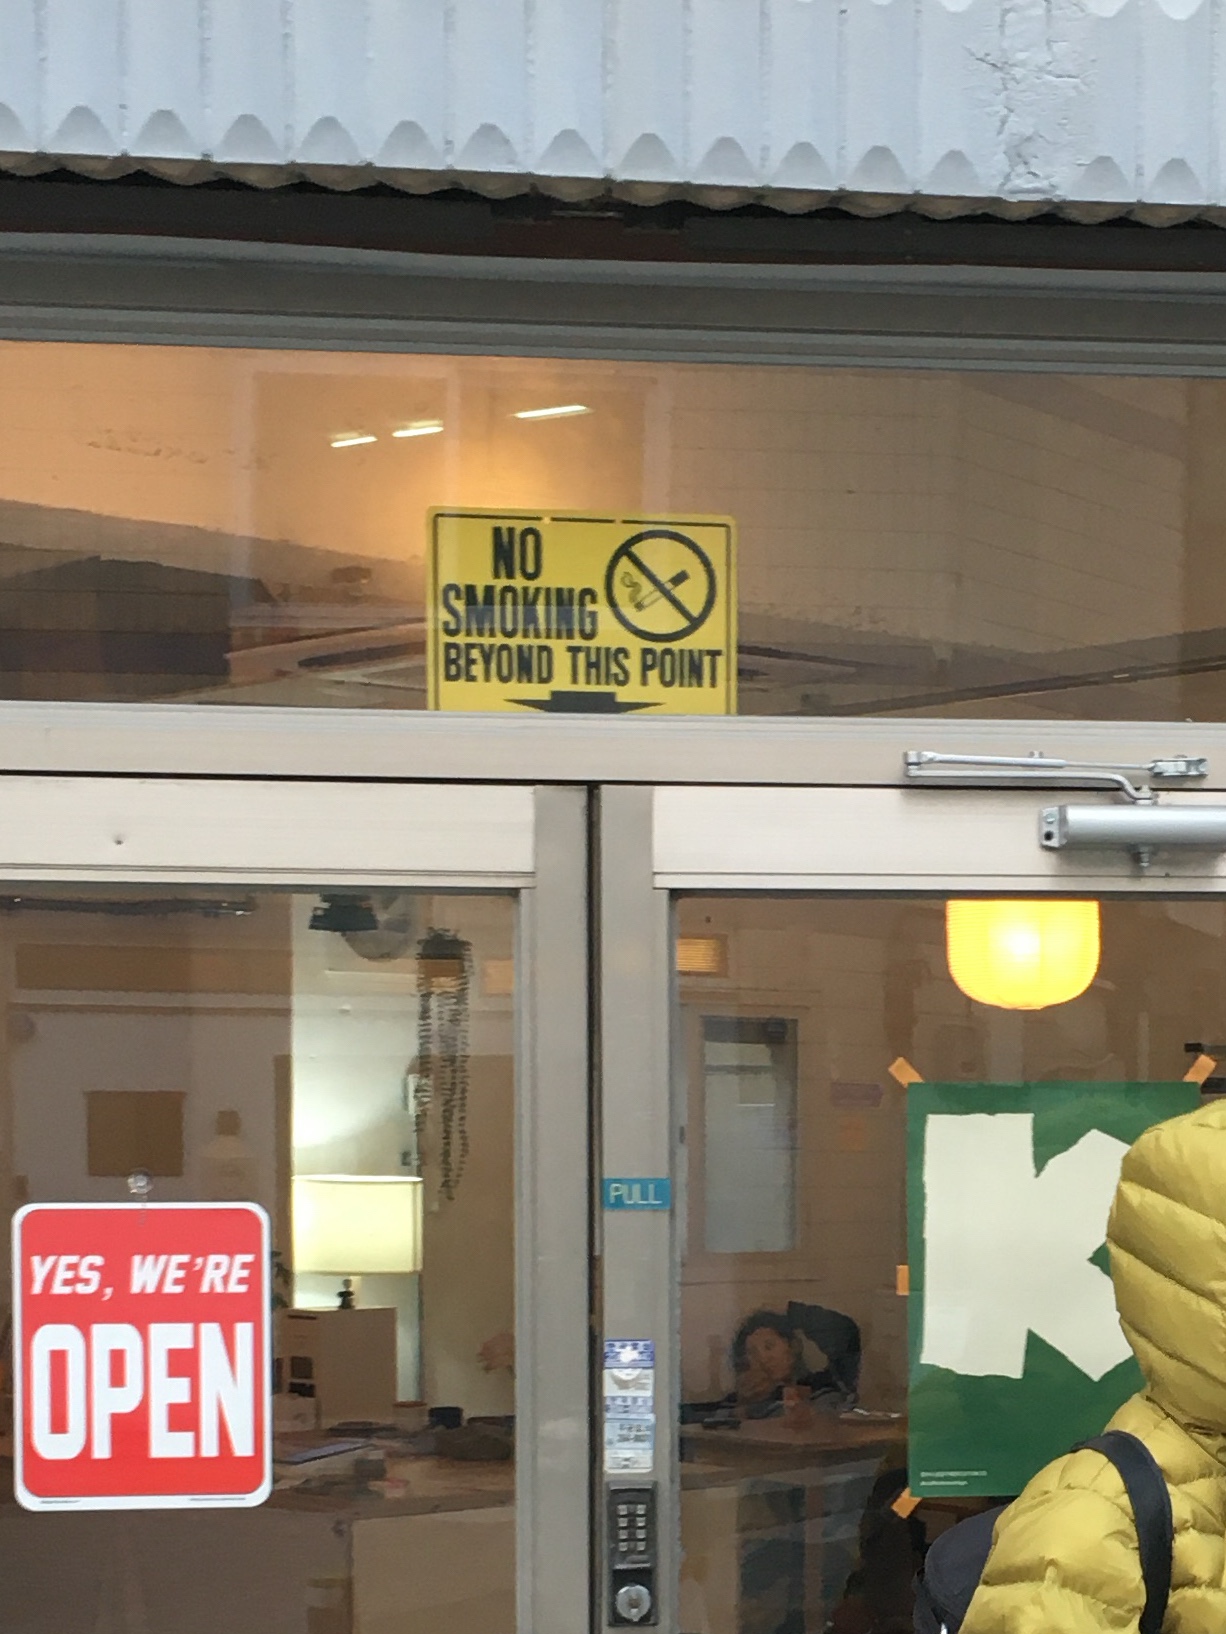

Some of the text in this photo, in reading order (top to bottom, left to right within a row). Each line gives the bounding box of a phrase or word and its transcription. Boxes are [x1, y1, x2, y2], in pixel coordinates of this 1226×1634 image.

[493, 526, 543, 581] NO
[442, 583, 599, 641] SMOKING
[444, 642, 723, 689] BEYOND THIS POINT
[609, 1183, 662, 1205] PULL
[30, 1253, 255, 1301] YES, WE'RE
[31, 1322, 255, 1460] OPEN
